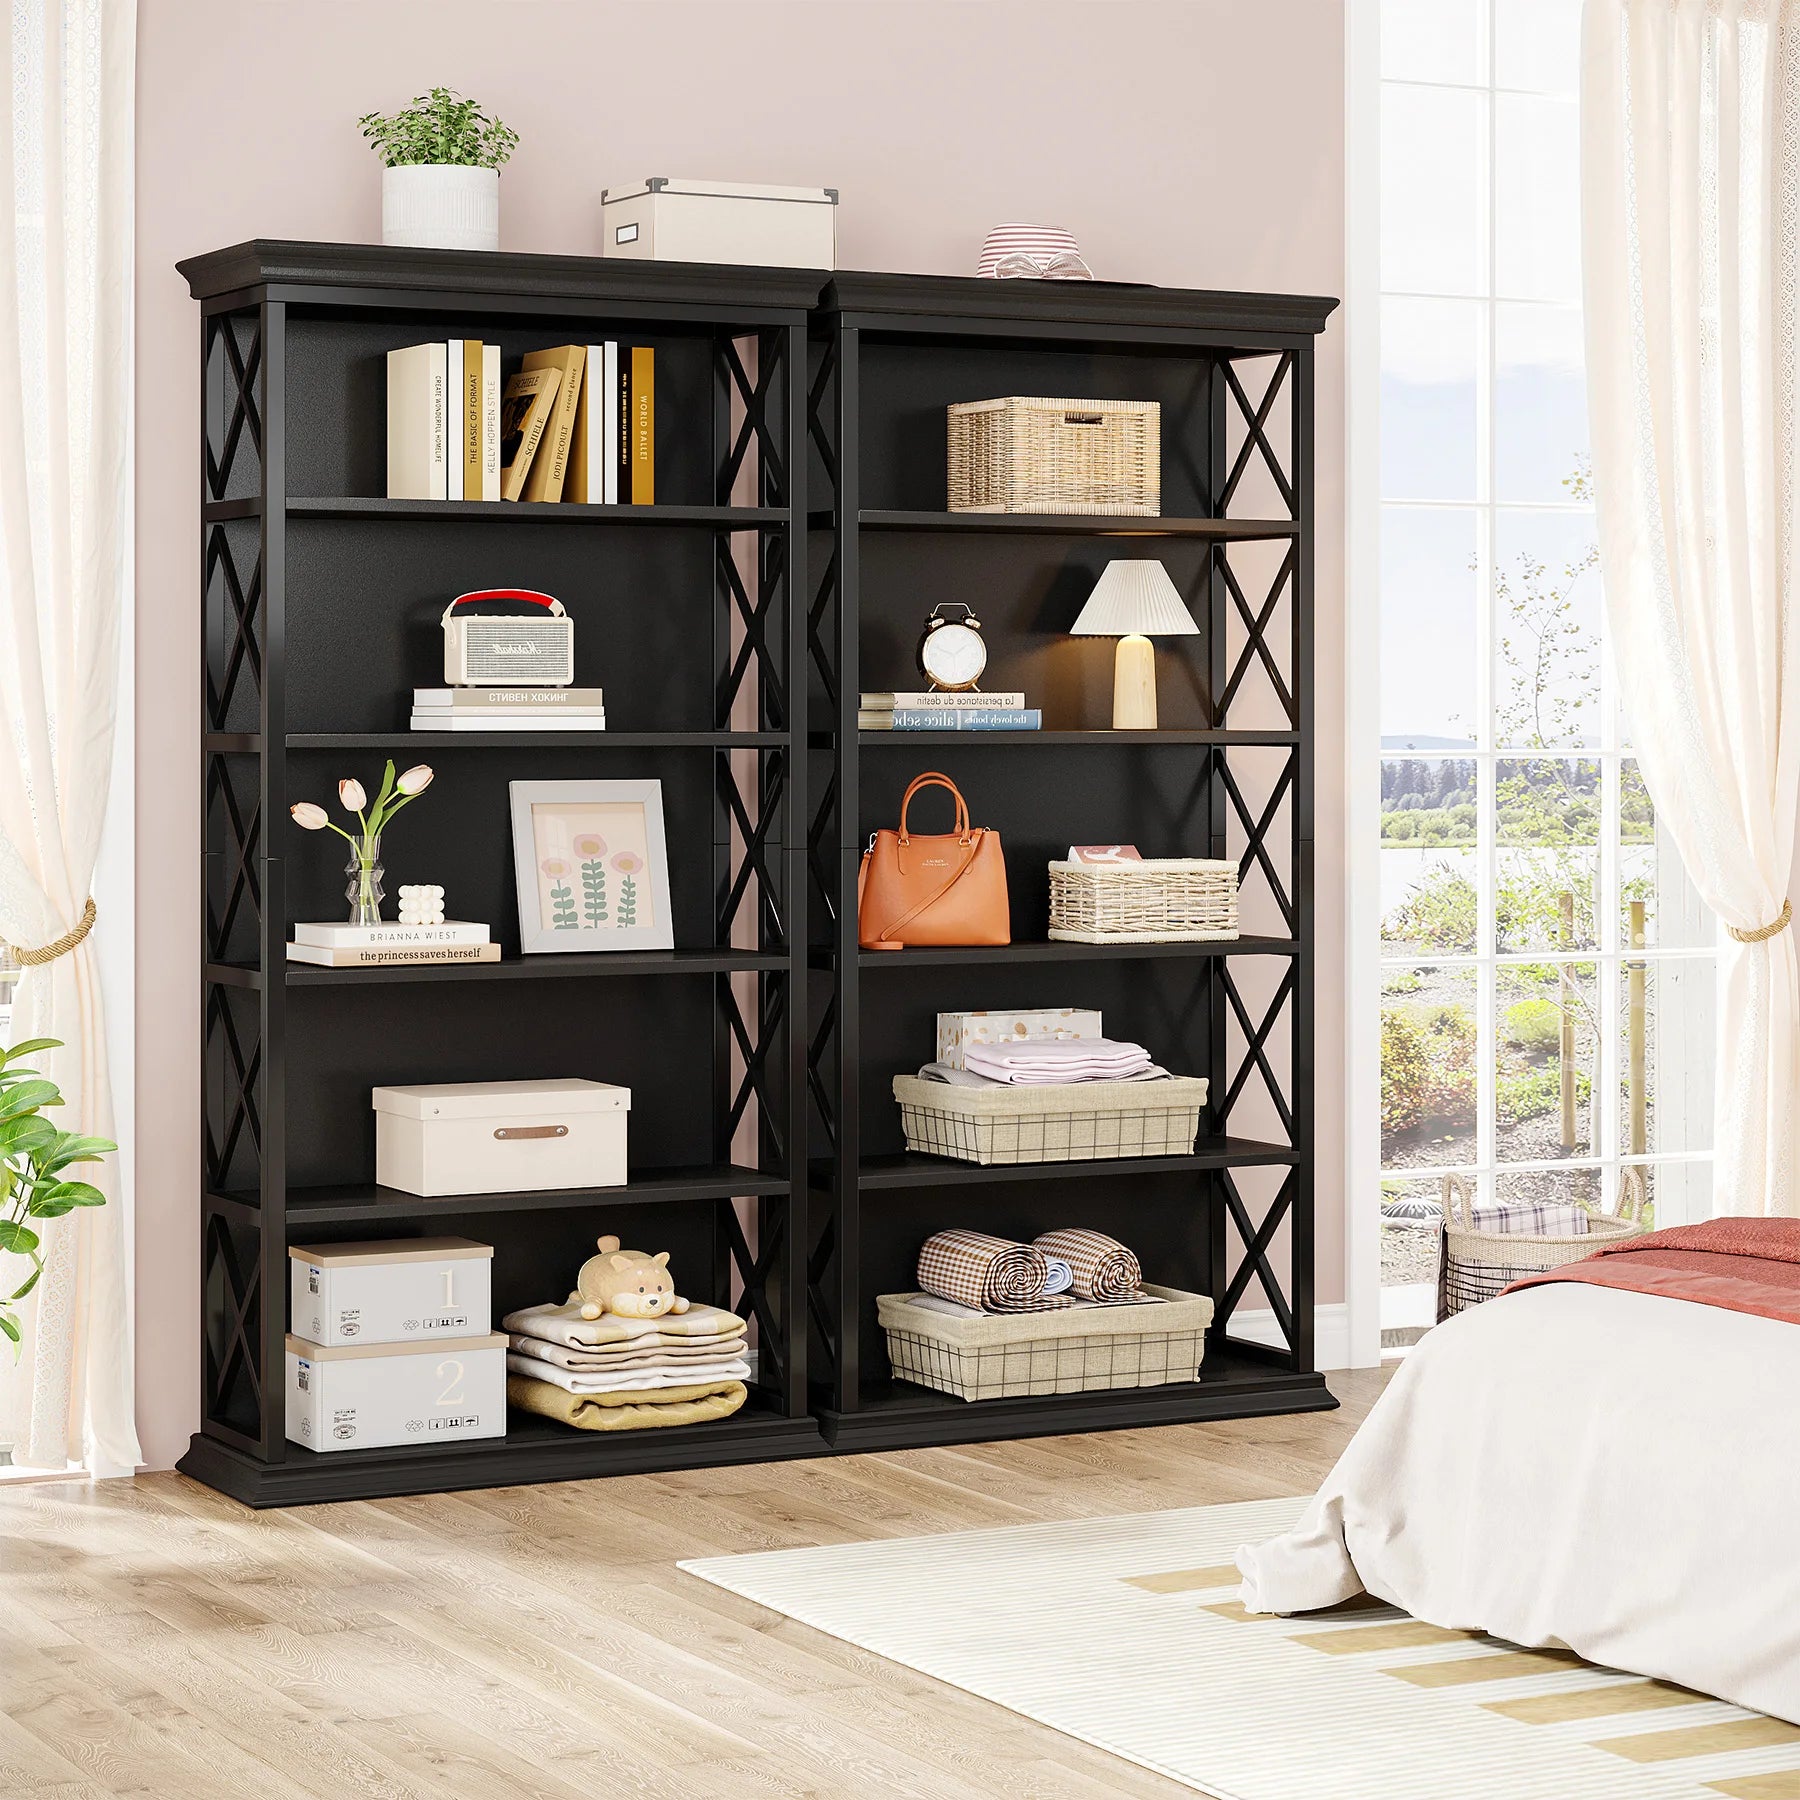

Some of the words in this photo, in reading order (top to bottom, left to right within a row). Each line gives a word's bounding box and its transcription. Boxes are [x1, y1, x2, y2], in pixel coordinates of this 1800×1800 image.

[487, 380, 496, 406] STYLE
[566, 389, 574, 412] second
[470, 410, 477, 421] OF
[640, 395, 648, 427] WORLD
[487, 409, 496, 444] HOPPEN
[525, 418, 544, 456] SCHIELE
[556, 425, 568, 461] PICOULT
[640, 430, 648, 461] BALLET
[487, 446, 496, 474] KELLY
[553, 461, 562, 480] JODI
[488, 693, 528, 702] СТИВЕН
[531, 693, 569, 702] ХОКИНГ
[370, 932, 420, 942] BRIANNA
[424, 931, 458, 940] WIEST
[360, 951, 377, 961] the
[378, 950, 419, 963] princess
[420, 951, 446, 960] saves
[447, 948, 481, 959] herself
[439, 1268, 460, 1309] 1
[435, 1359, 465, 1407] 2
